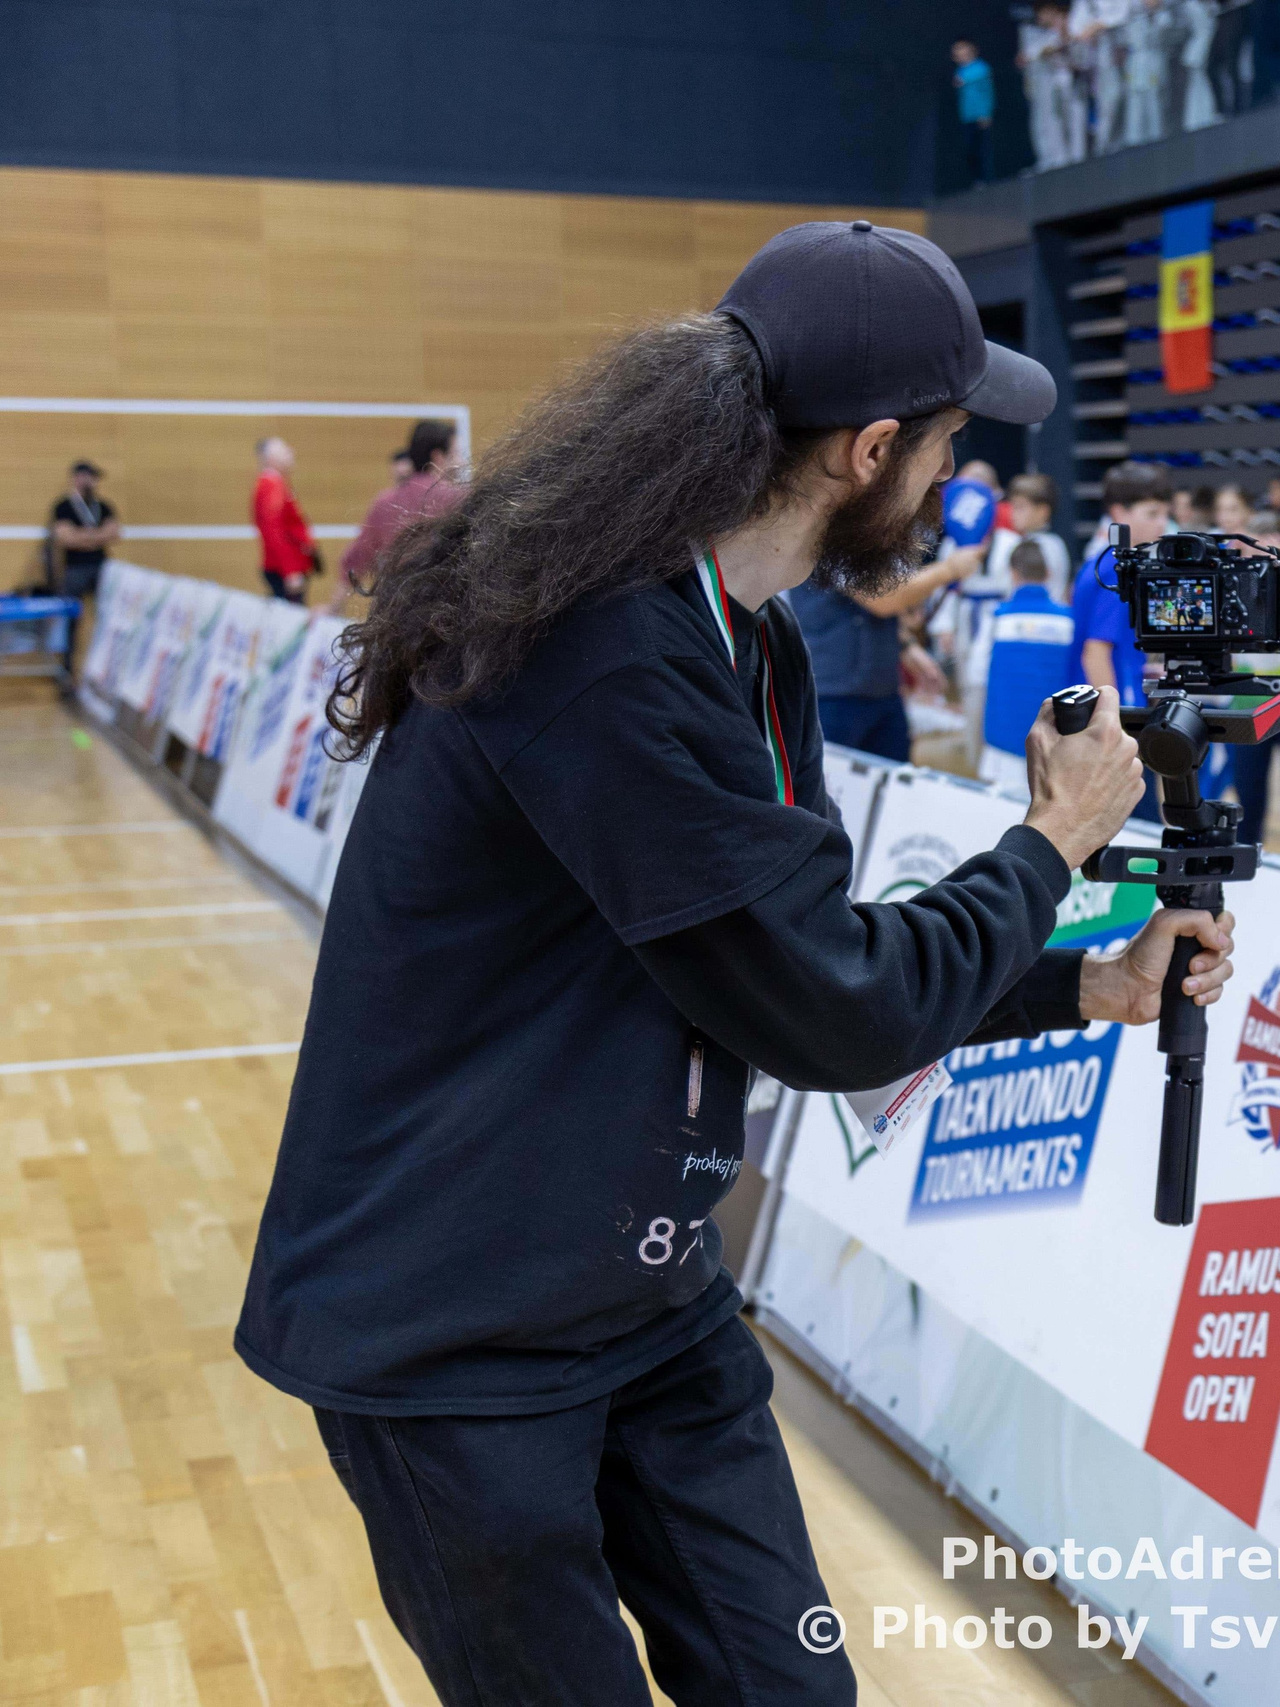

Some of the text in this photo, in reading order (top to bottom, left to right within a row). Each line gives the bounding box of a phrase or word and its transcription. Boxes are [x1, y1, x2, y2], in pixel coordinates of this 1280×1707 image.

[933, 1055, 1103, 1144] TAEKWONDO
[921, 1132, 1083, 1204] TOURNAMENTS
[1193, 1311, 1270, 1359] SOFIA
[1182, 1374, 1256, 1423] OPEN
